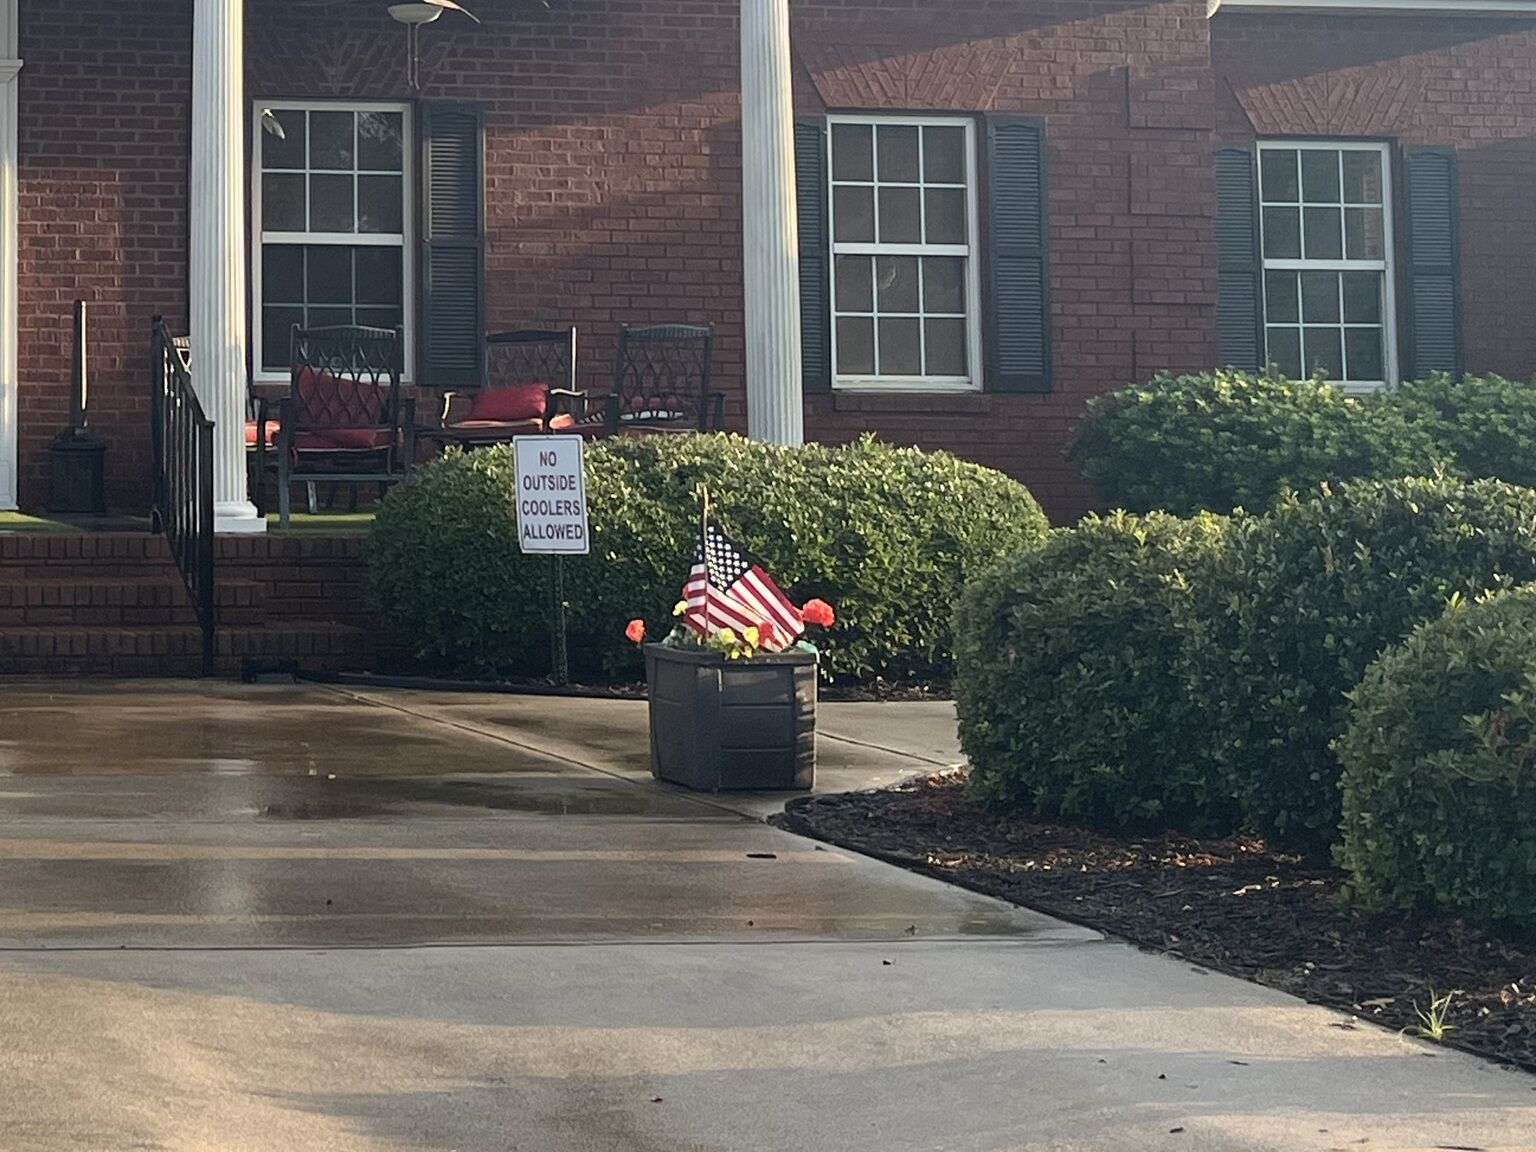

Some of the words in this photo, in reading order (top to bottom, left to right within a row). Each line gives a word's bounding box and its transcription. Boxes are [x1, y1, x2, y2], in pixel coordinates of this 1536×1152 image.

[539, 451, 557, 467] NO
[523, 475, 576, 491] OUTSIDE
[522, 500, 581, 516] COOLERS
[524, 524, 583, 540] ALLOWED
